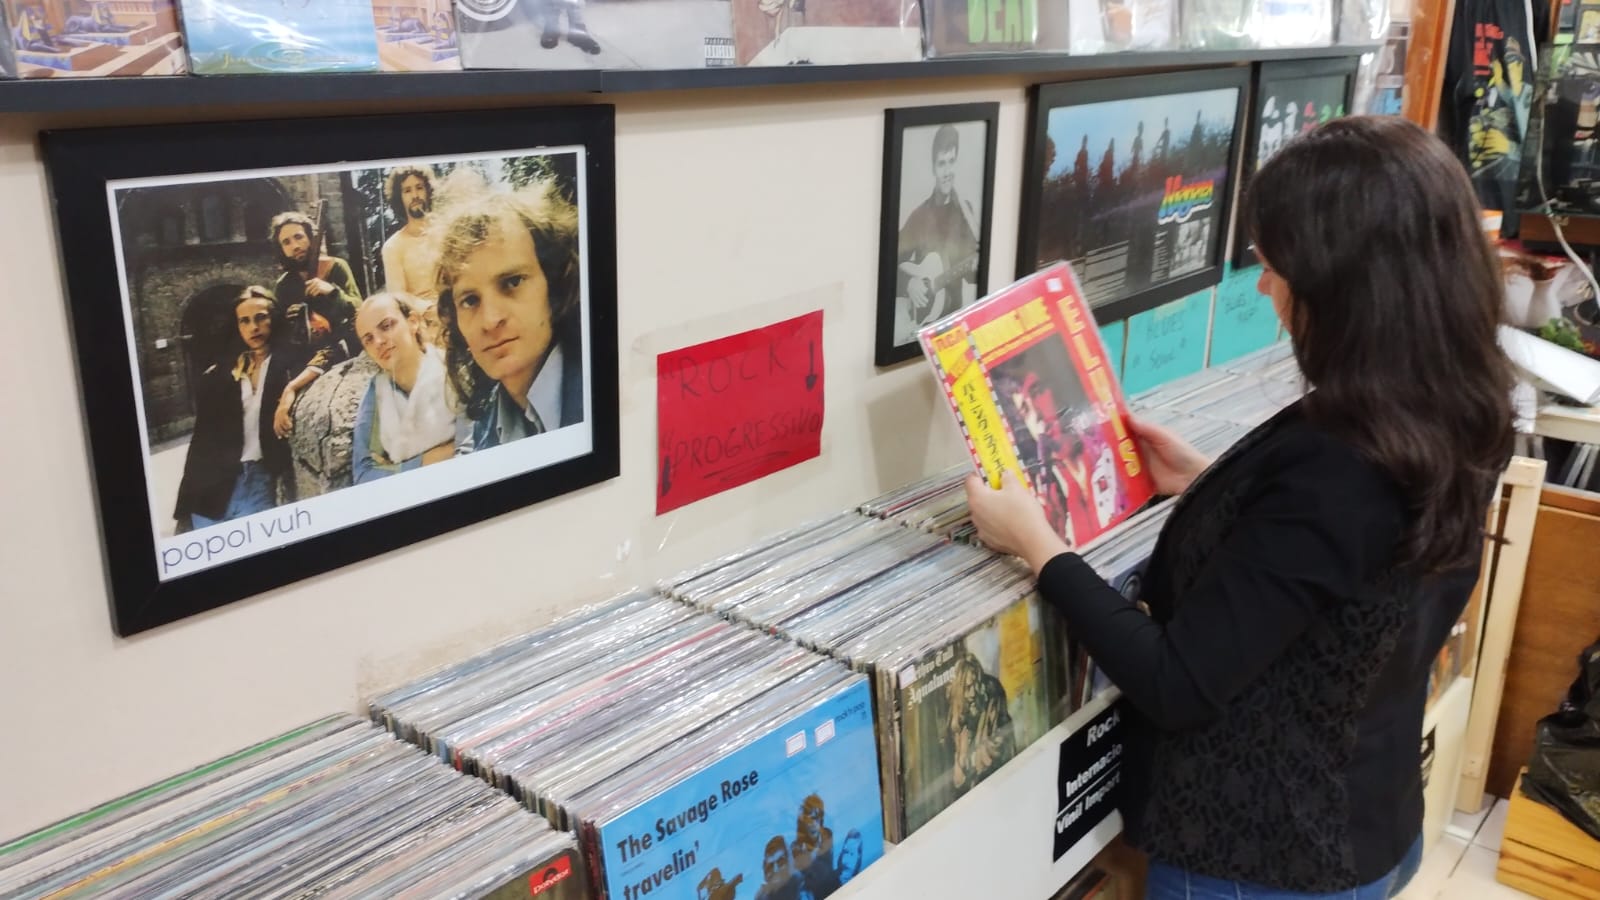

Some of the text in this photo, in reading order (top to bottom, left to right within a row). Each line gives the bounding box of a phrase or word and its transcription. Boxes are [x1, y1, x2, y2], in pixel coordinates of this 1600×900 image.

[162, 507, 312, 574] popol vuh
[1086, 708, 1121, 747] Rock
[1066, 744, 1122, 797] Internacio
[617, 770, 759, 863] The Savage Rose
[1057, 771, 1120, 834] Vinil Import
[623, 840, 700, 900] travelin'
